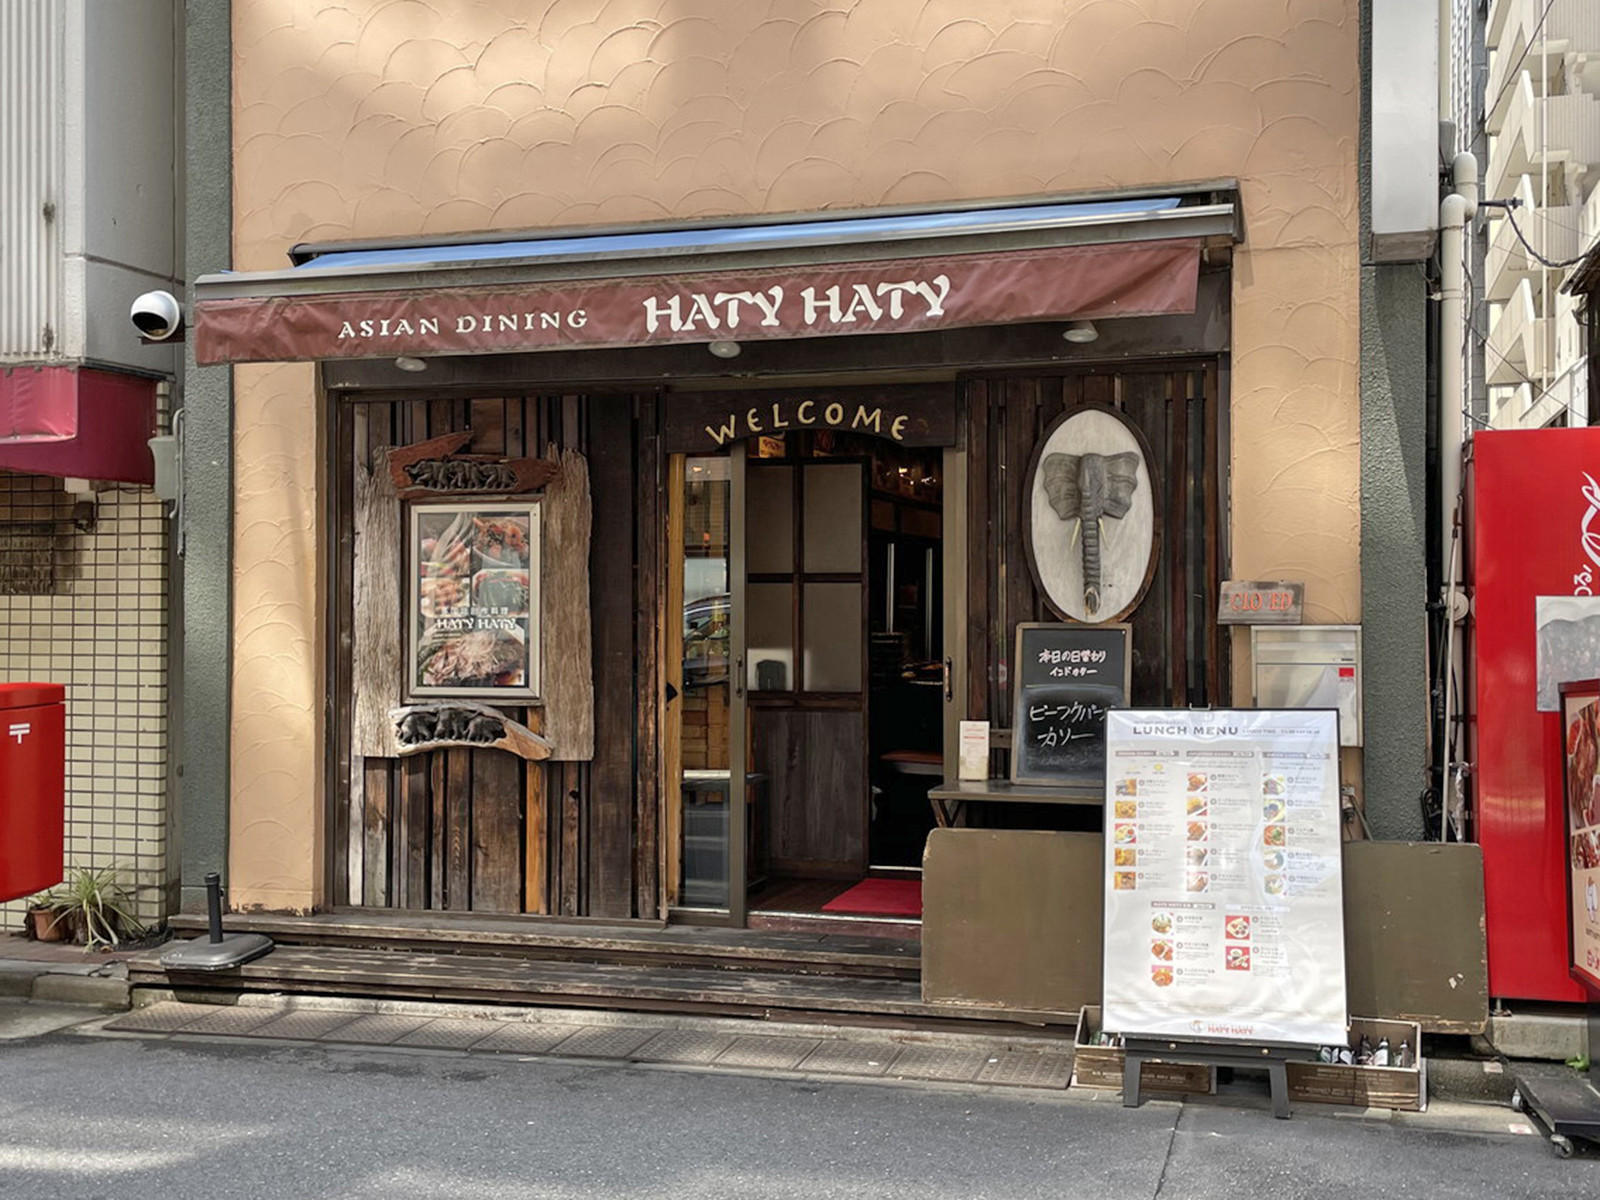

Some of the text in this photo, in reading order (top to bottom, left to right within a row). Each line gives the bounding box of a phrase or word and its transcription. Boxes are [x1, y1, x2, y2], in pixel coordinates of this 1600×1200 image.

[642, 274, 951, 333] HATY HATY
[338, 310, 588, 339] ASIAN DINING
[705, 400, 909, 445] WELCOME
[436, 617, 517, 630] HATY HATY
[1133, 726, 1187, 735] LUNCH
[1193, 726, 1238, 736] MENU
